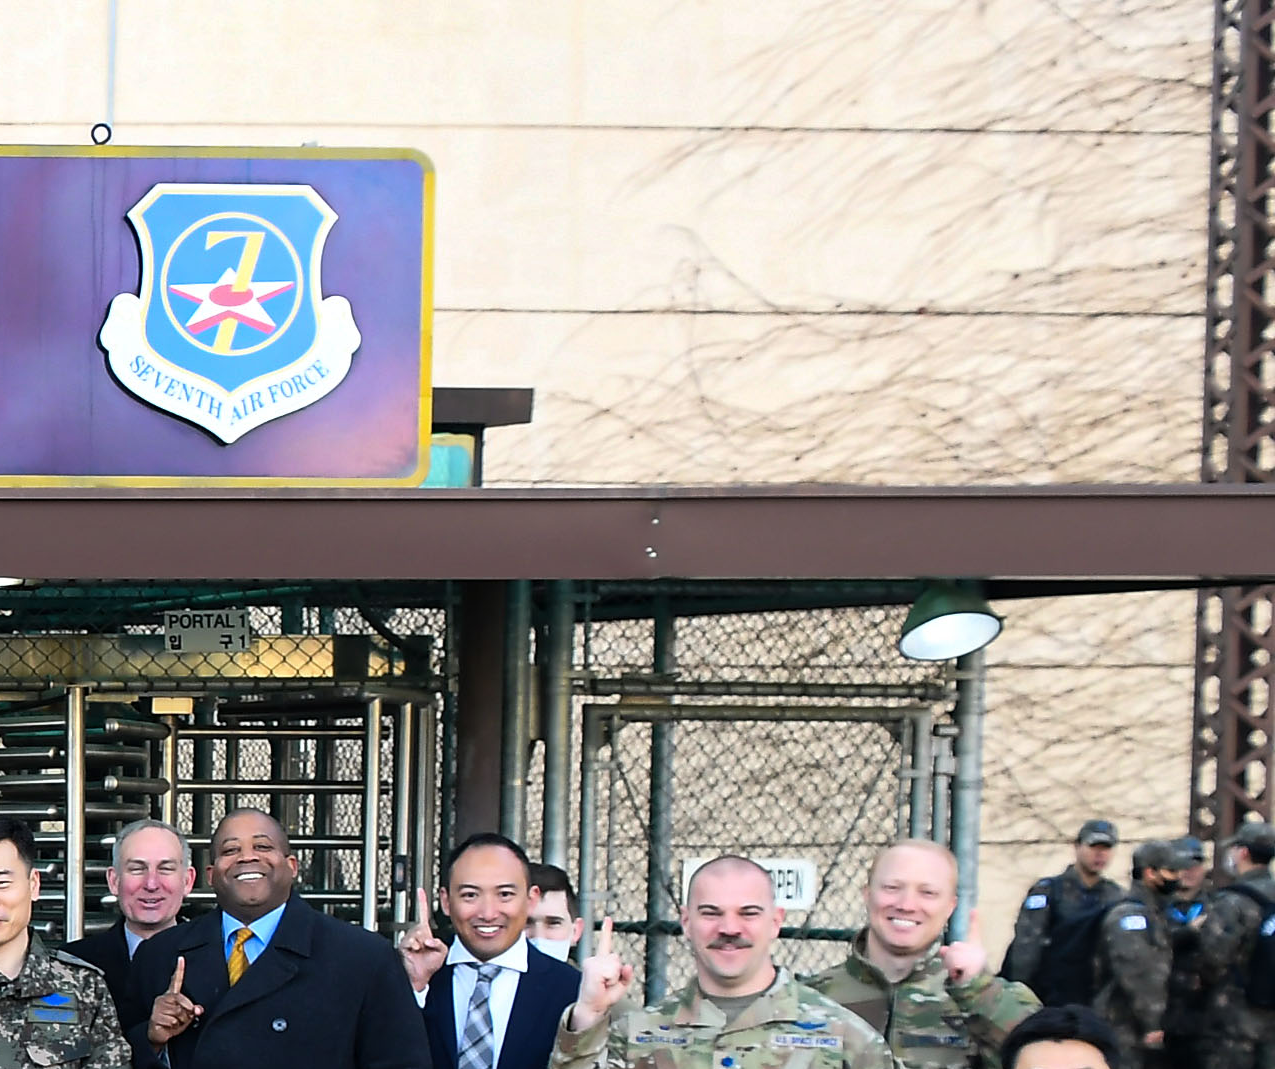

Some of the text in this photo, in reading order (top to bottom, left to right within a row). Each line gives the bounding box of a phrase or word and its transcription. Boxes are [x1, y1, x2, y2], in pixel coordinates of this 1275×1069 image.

[129, 354, 331, 426] SEVENTH AIR FORCE
[168, 613, 246, 629] PORTAL 1
[238, 634, 246, 650] 1
[770, 869, 804, 899] PEN
